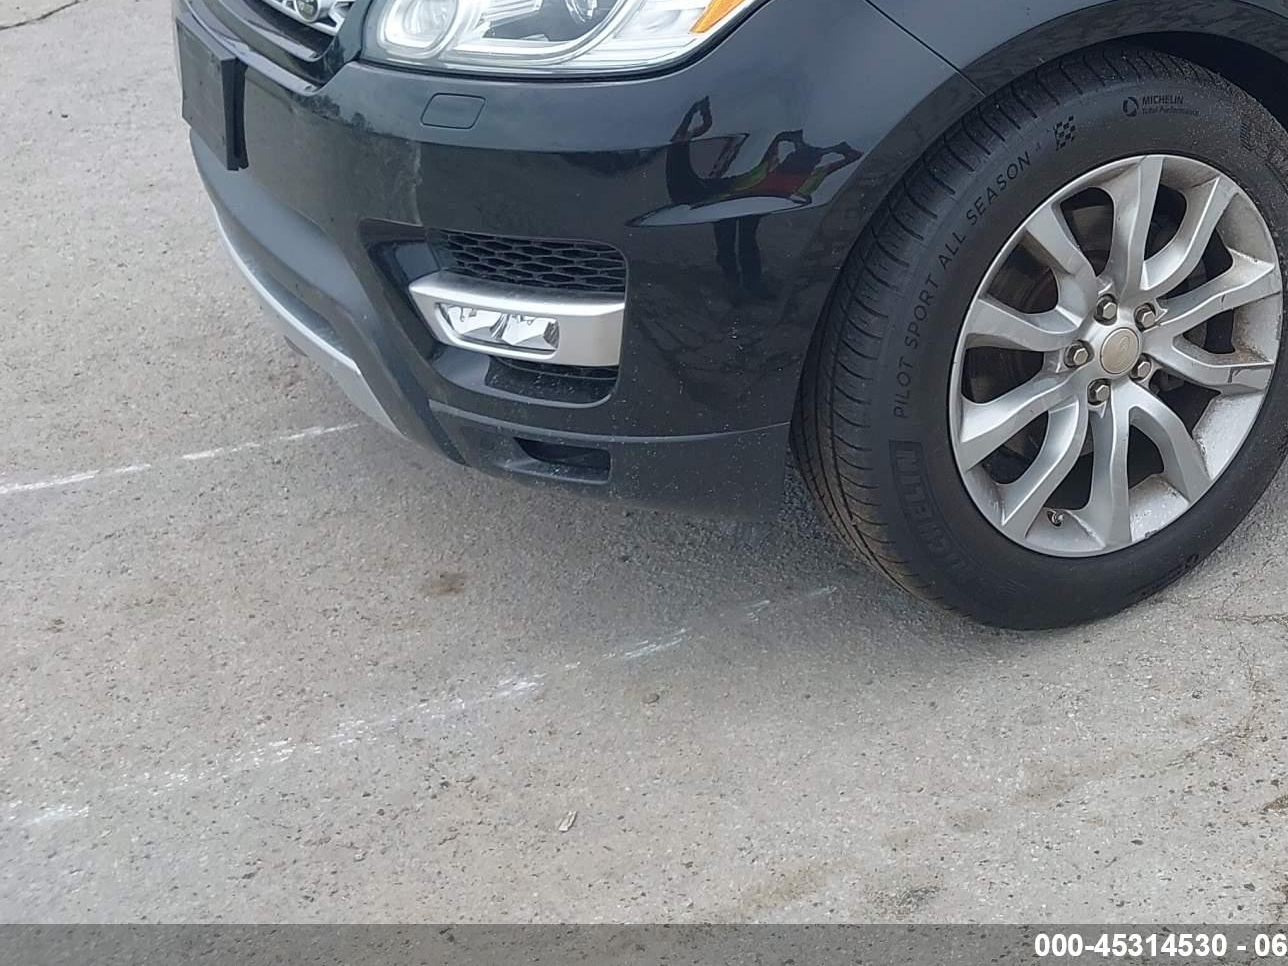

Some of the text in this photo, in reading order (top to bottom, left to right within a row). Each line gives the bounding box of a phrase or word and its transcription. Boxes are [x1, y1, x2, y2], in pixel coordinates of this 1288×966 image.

[1142, 95, 1184, 105] MICHELIN
[894, 356, 913, 418] PILOT
[904, 274, 939, 350] SPORT
[936, 230, 967, 270] ALL
[965, 151, 1031, 227] SEASON
